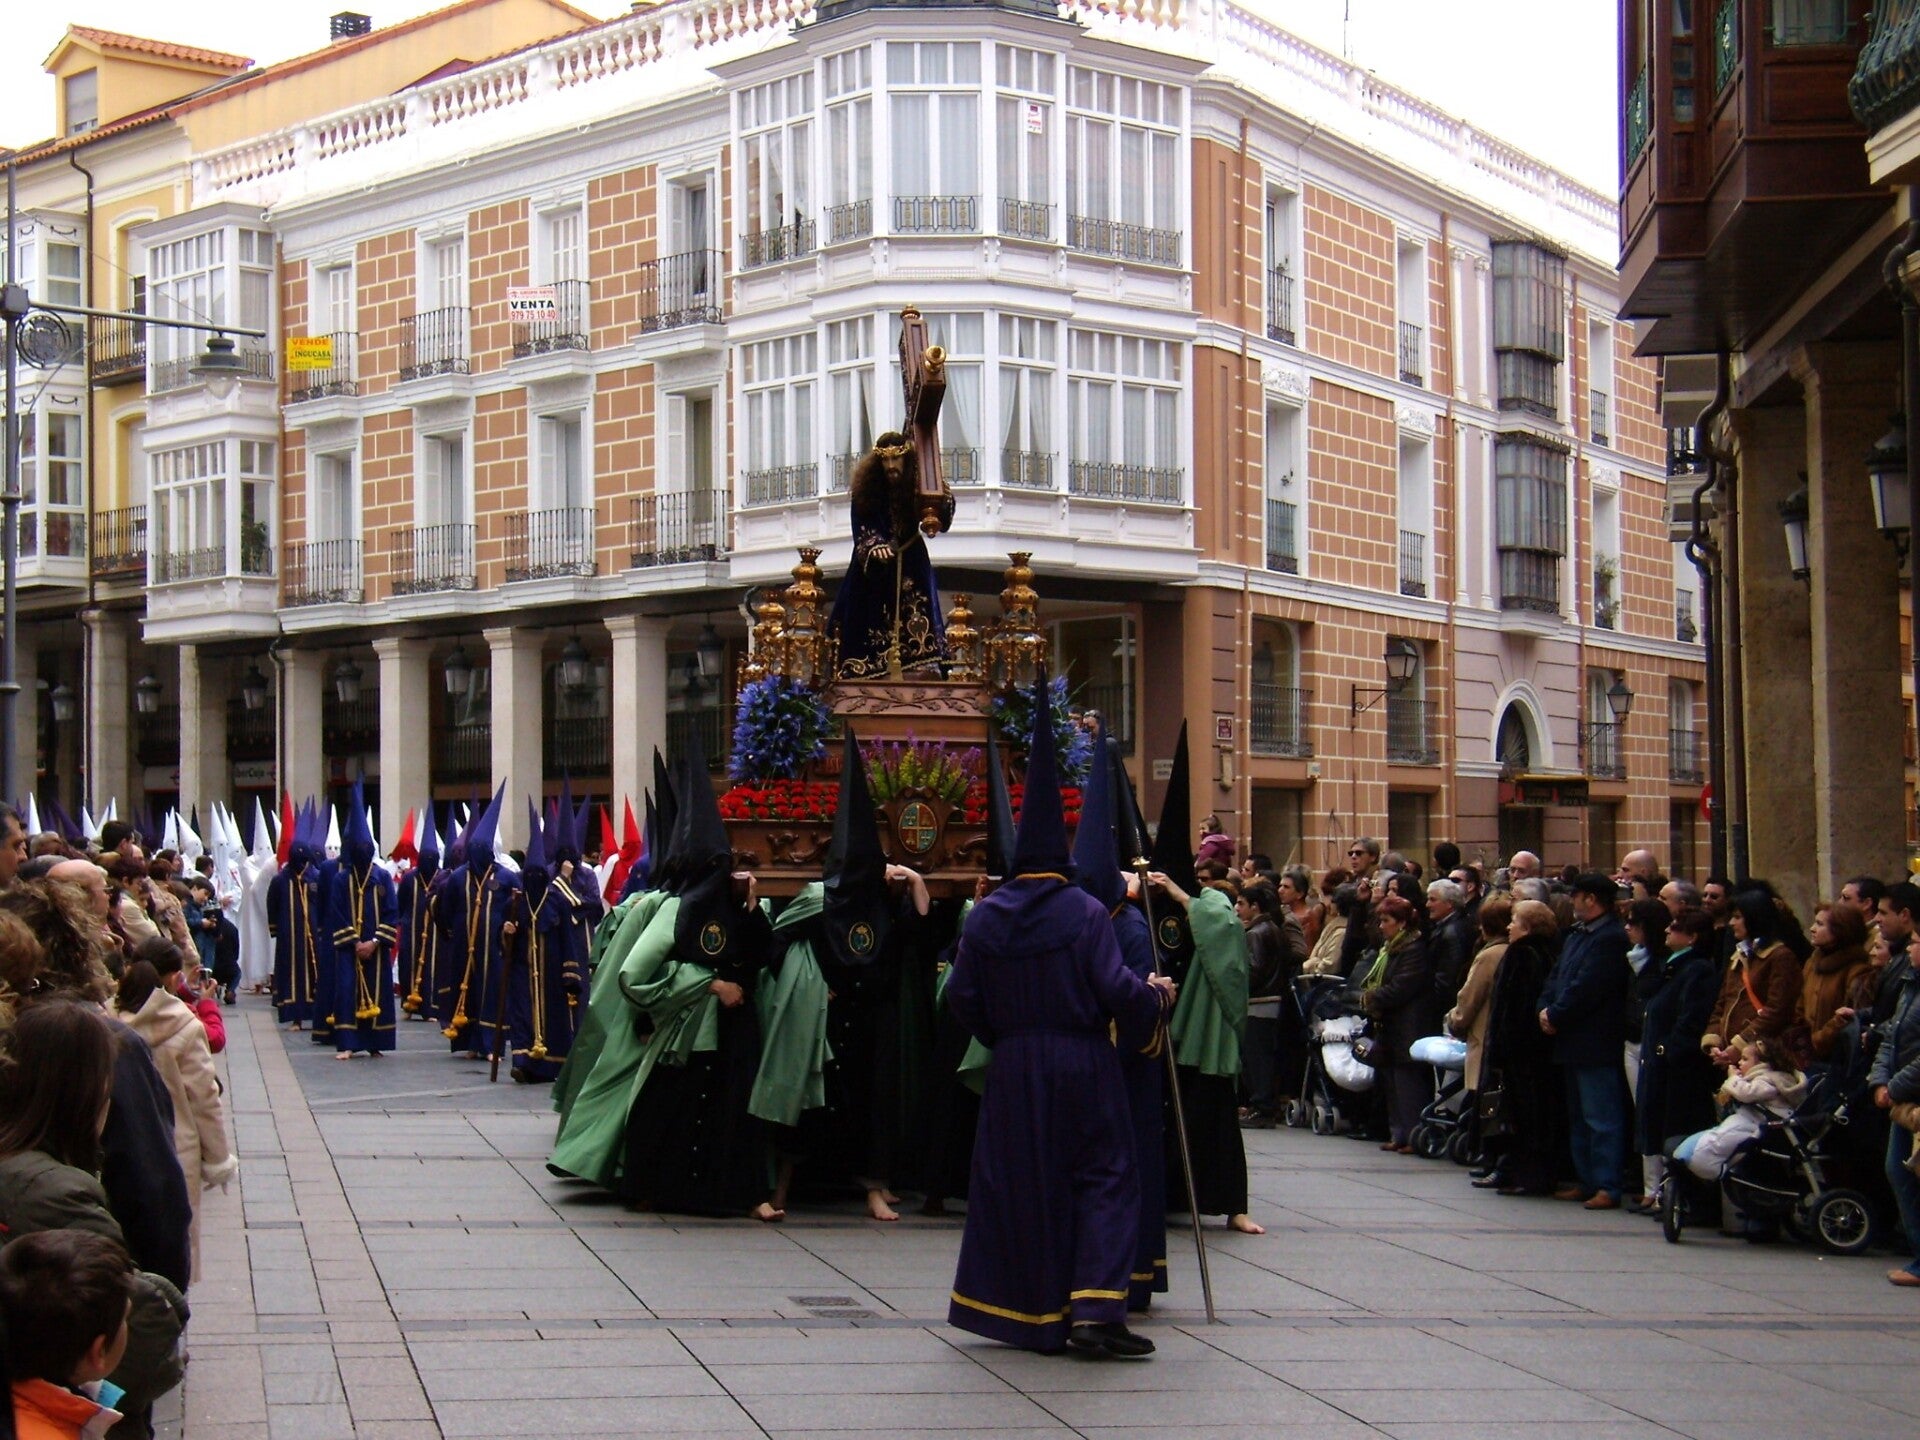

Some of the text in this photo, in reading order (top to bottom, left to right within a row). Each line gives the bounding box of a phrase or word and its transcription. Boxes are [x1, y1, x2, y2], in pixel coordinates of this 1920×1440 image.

[511, 300, 554, 309] VENTA
[511, 310, 524, 320] 979
[526, 310, 535, 320] 75
[537, 310, 545, 319] 10
